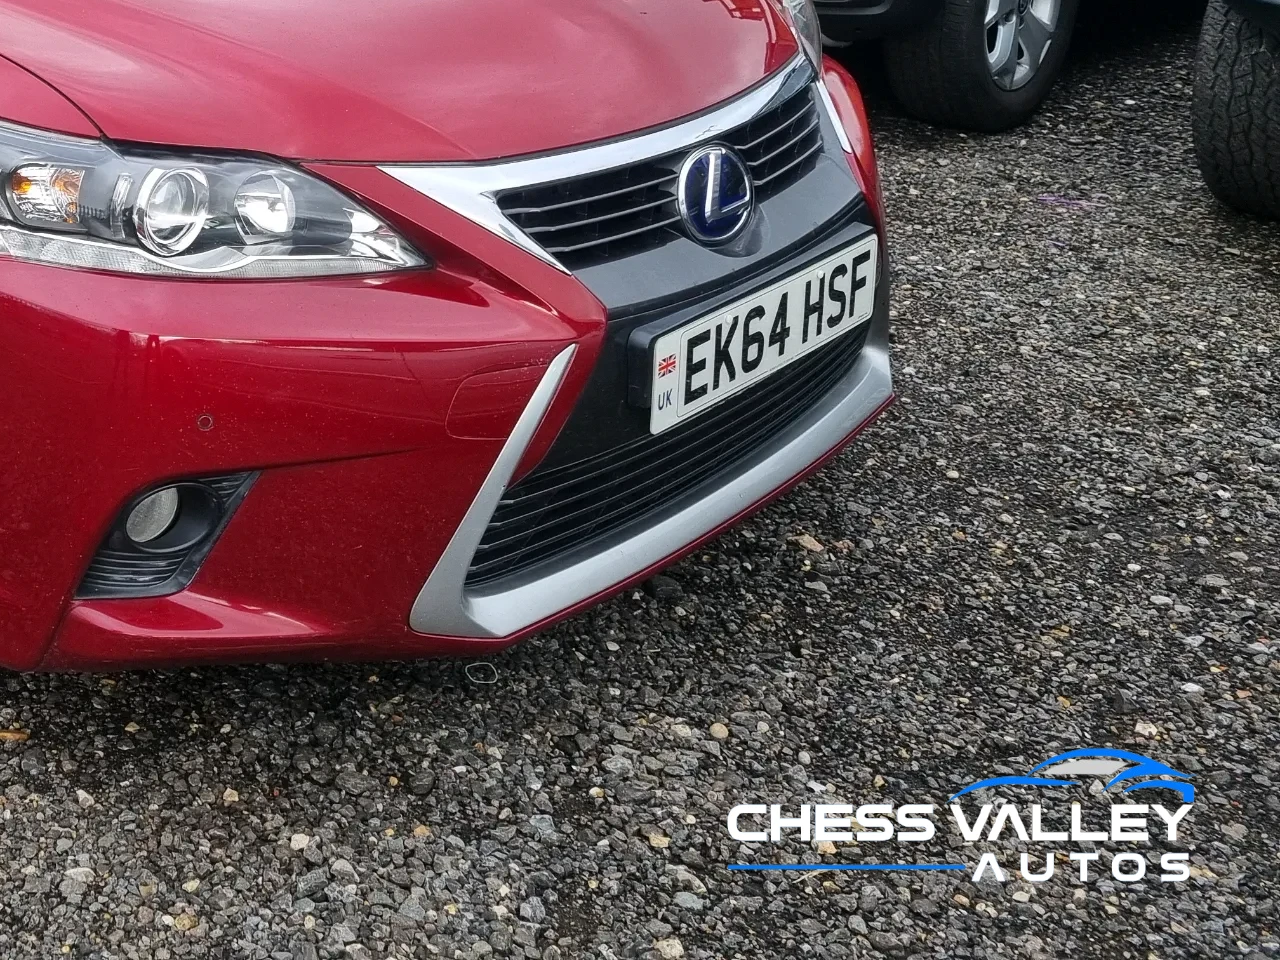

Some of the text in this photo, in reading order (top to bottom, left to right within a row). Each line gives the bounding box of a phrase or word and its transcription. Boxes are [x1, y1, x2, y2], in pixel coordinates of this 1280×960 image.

[684, 249, 871, 406] EK64 HSF
[657, 388, 673, 411] UK
